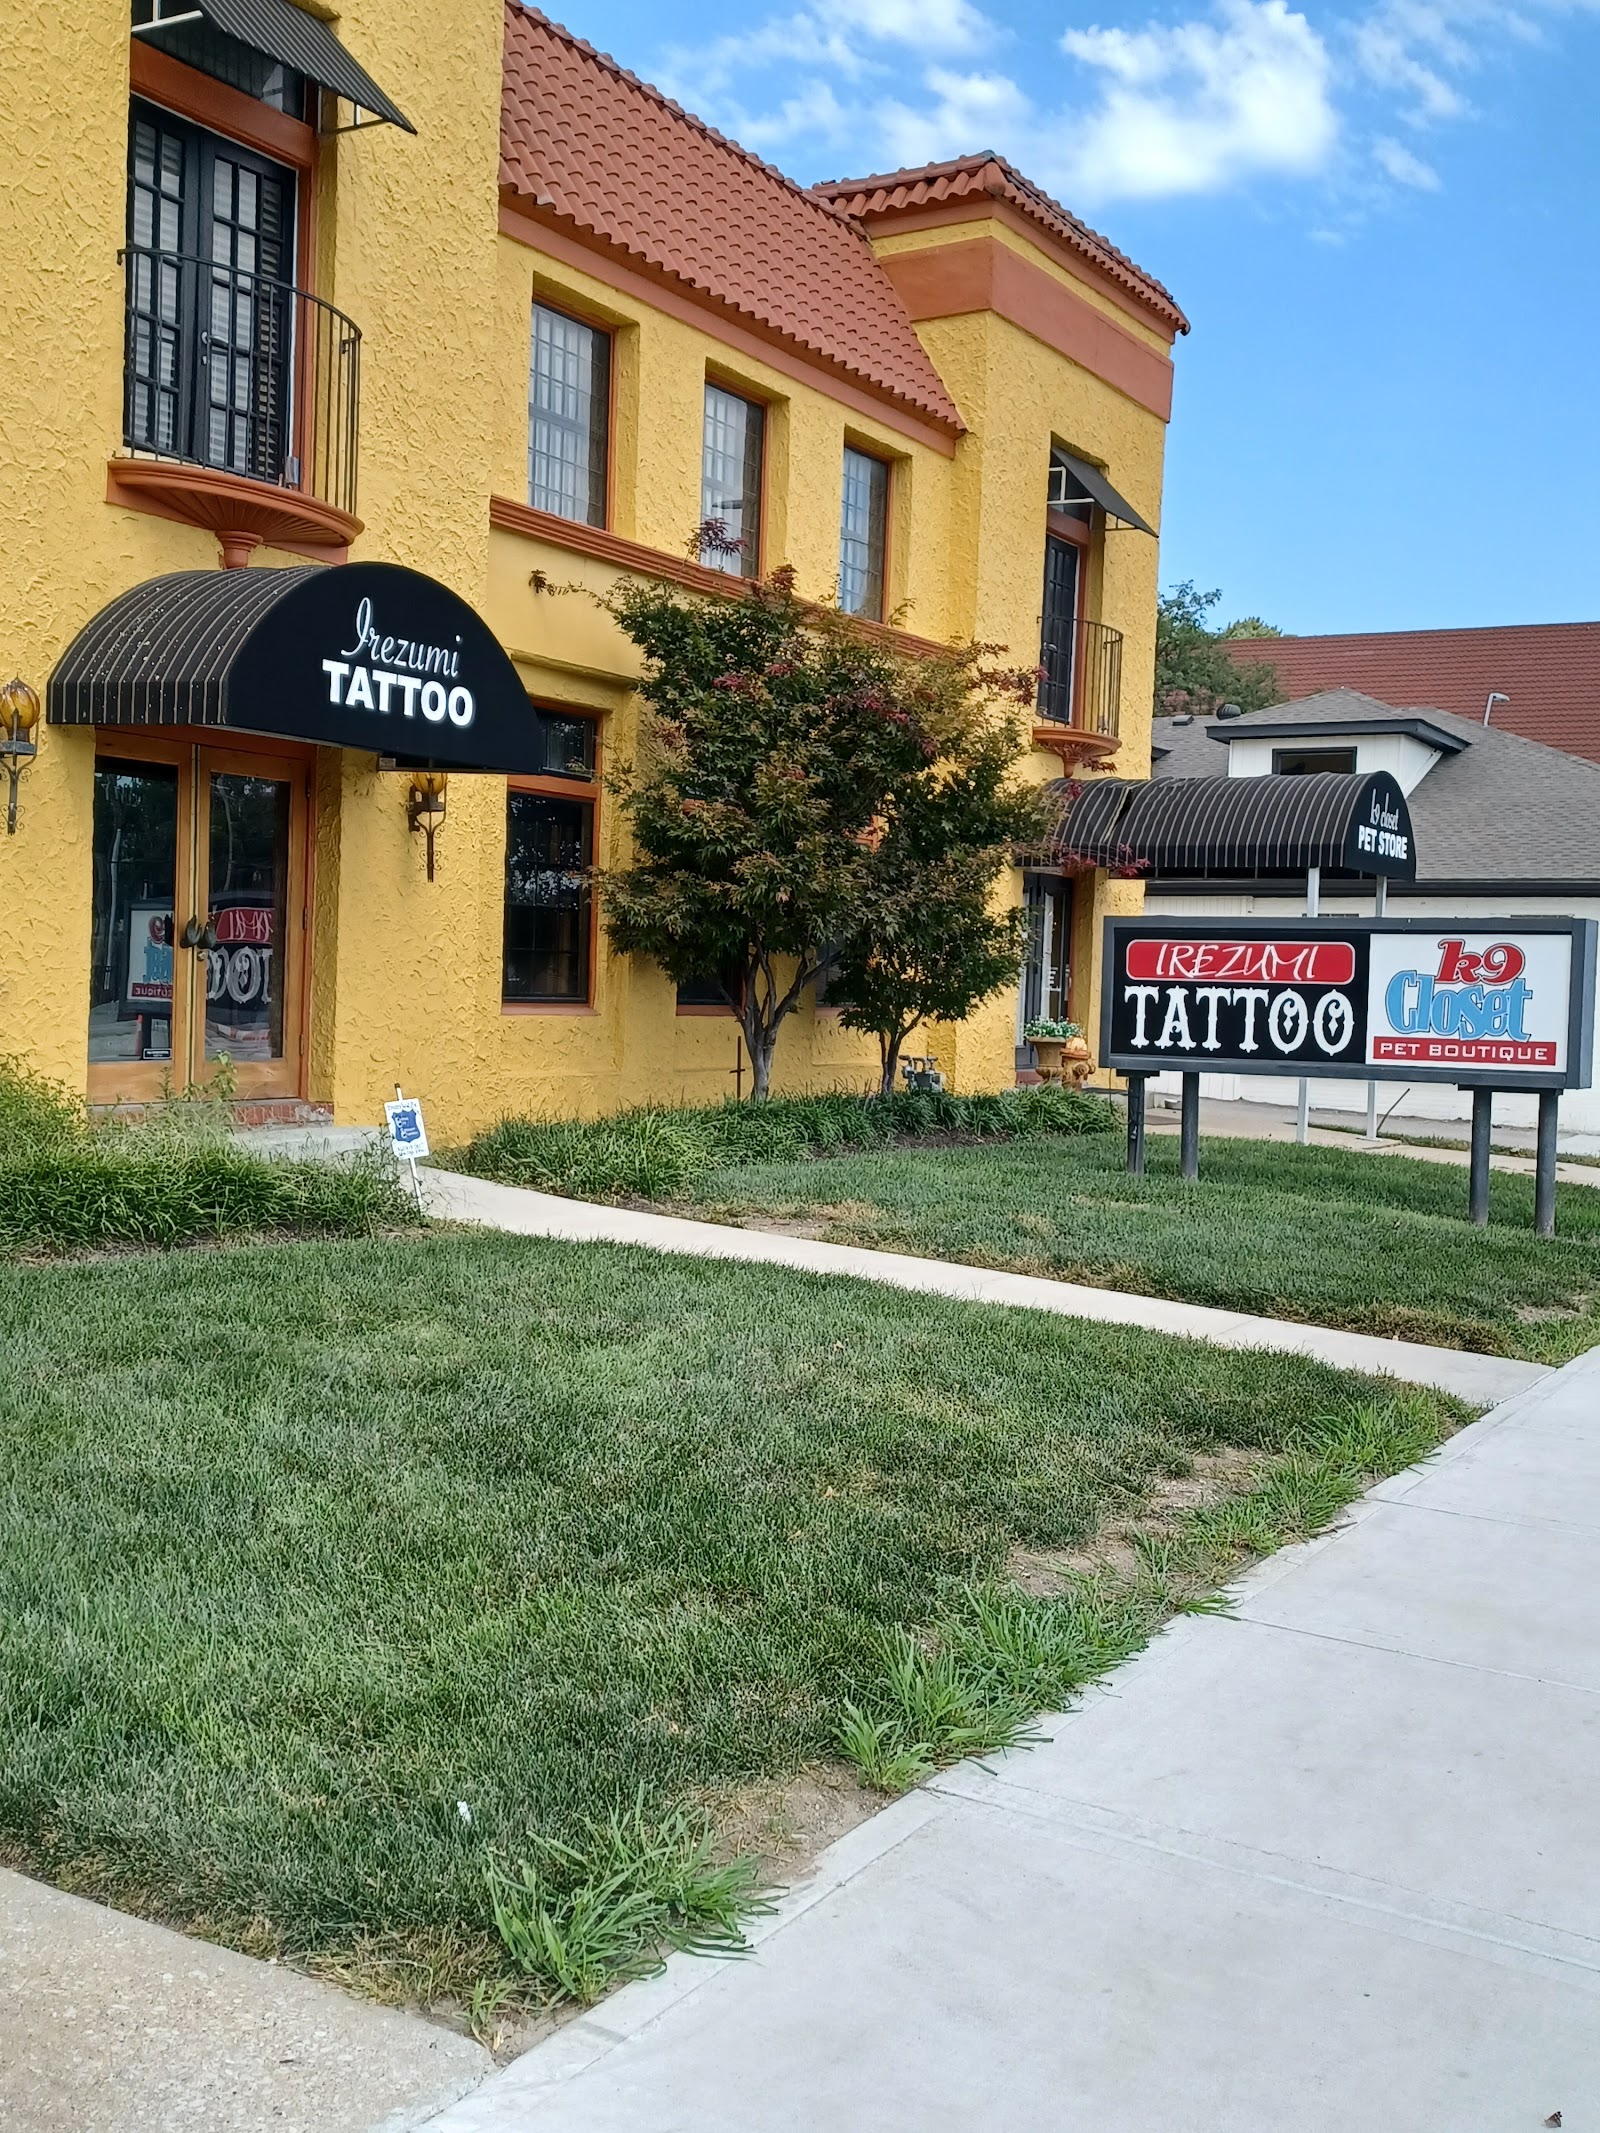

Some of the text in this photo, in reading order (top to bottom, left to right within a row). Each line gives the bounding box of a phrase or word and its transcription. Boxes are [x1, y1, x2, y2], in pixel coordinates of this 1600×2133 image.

[341, 597, 460, 677] Irezumi
[322, 659, 473, 726] TATTOO
[1358, 825, 1408, 860] PET STORE
[1156, 943, 1319, 981] IREZUMI
[1124, 984, 1355, 1056] TATTOO
[1385, 970, 1533, 1043] Closet
[1380, 1042, 1548, 1061] PET BOUTIQUE
